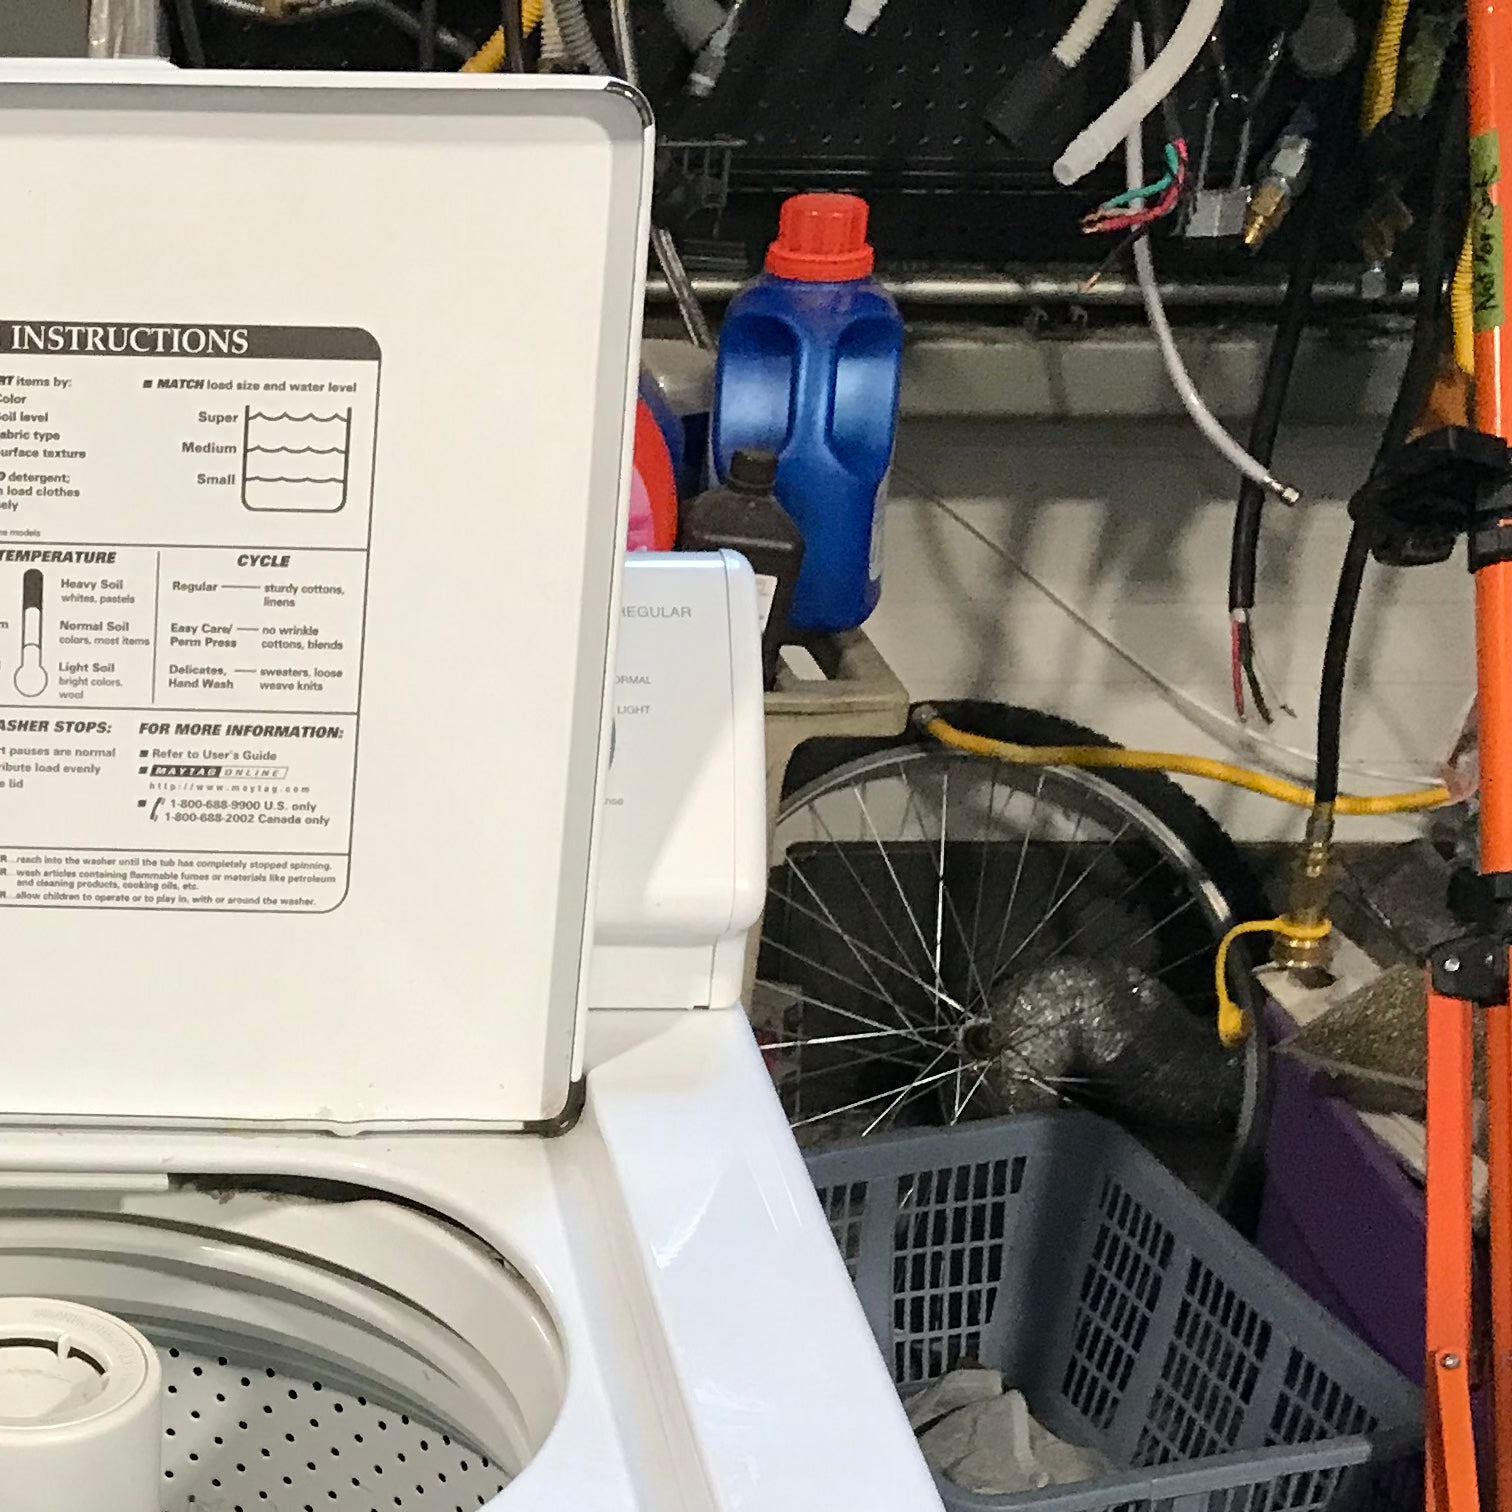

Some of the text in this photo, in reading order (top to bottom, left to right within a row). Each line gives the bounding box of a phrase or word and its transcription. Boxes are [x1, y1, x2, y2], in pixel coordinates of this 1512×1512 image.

[11, 325, 249, 354] INSTRUCTIONS
[16, 376, 50, 387] items
[53, 377, 72, 388] by:
[156, 378, 357, 393] MATCH load size and water level
[20, 412, 49, 422] level
[198, 411, 239, 425] Super
[34, 430, 60, 442] type
[181, 442, 237, 454] Medium
[43, 449, 86, 459] texture
[197, 473, 236, 485] Small
[7, 486, 33, 496] load
[36, 486, 80, 497] clothes
[237, 554, 291, 568] CYCLE
[61, 579, 124, 590] Heavy Soil
[172, 581, 218, 592] Regular
[264, 584, 345, 595] sturdy cottons,
[99, 594, 135, 605] pastels
[263, 597, 296, 607] linens
[60, 621, 130, 632] Normal Soil
[170, 623, 199, 635] Easy
[262, 626, 319, 636] no wrinkle
[94, 637, 120, 645] most
[122, 637, 150, 646] items
[170, 637, 237, 648] Perm Press
[261, 640, 344, 650] cottons, blends
[59, 662, 115, 673] Light Soil
[169, 665, 227, 675] Delicates,
[314, 668, 343, 678] loose
[59, 676, 89, 688] bright
[168, 678, 234, 689] Hand Wash
[260, 681, 323, 691] weave knits
[59, 690, 84, 699] wool
[617, 705, 651, 714] LIGHT
[53, 720, 113, 734] STOPS:
[138, 722, 344, 739] FOR MORE INFORMATION:
[9, 747, 50, 757] pauses
[53, 748, 72, 756] are
[75, 747, 116, 757] normal
[152, 748, 184, 759] Refer
[187, 750, 200, 759] to
[242, 751, 278, 761] Guide
[35, 762, 60, 773] load
[64, 764, 101, 775] evenly
[224, 769, 280, 777] ONLINE
[9, 778, 24, 788] lid
[292, 801, 317, 813] only
[258, 814, 302, 824] Canada
[305, 815, 330, 826] only
